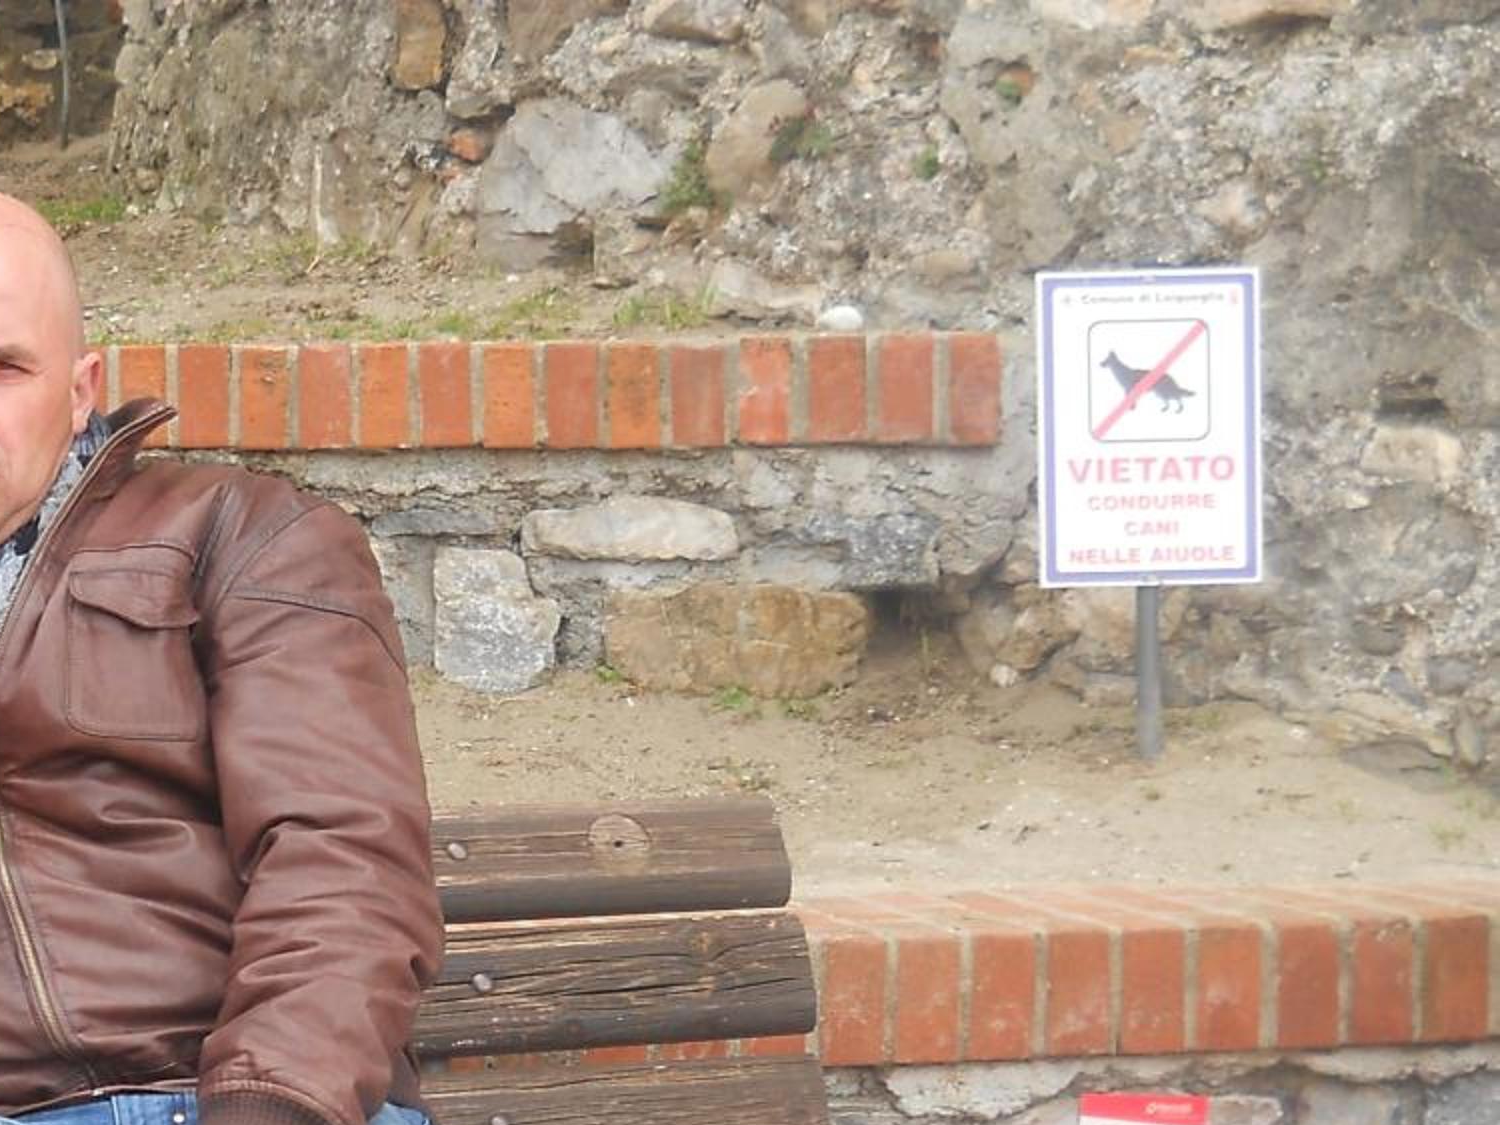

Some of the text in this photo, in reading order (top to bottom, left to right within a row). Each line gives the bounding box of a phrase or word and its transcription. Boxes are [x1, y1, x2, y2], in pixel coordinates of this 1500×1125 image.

[1081, 294, 1134, 304] Comune
[1068, 456, 1235, 482] VIETATO
[1088, 493, 1216, 511] CONDURRE
[1124, 521, 1179, 536] CANI
[1070, 546, 1236, 564] NELLE AIUOLE
